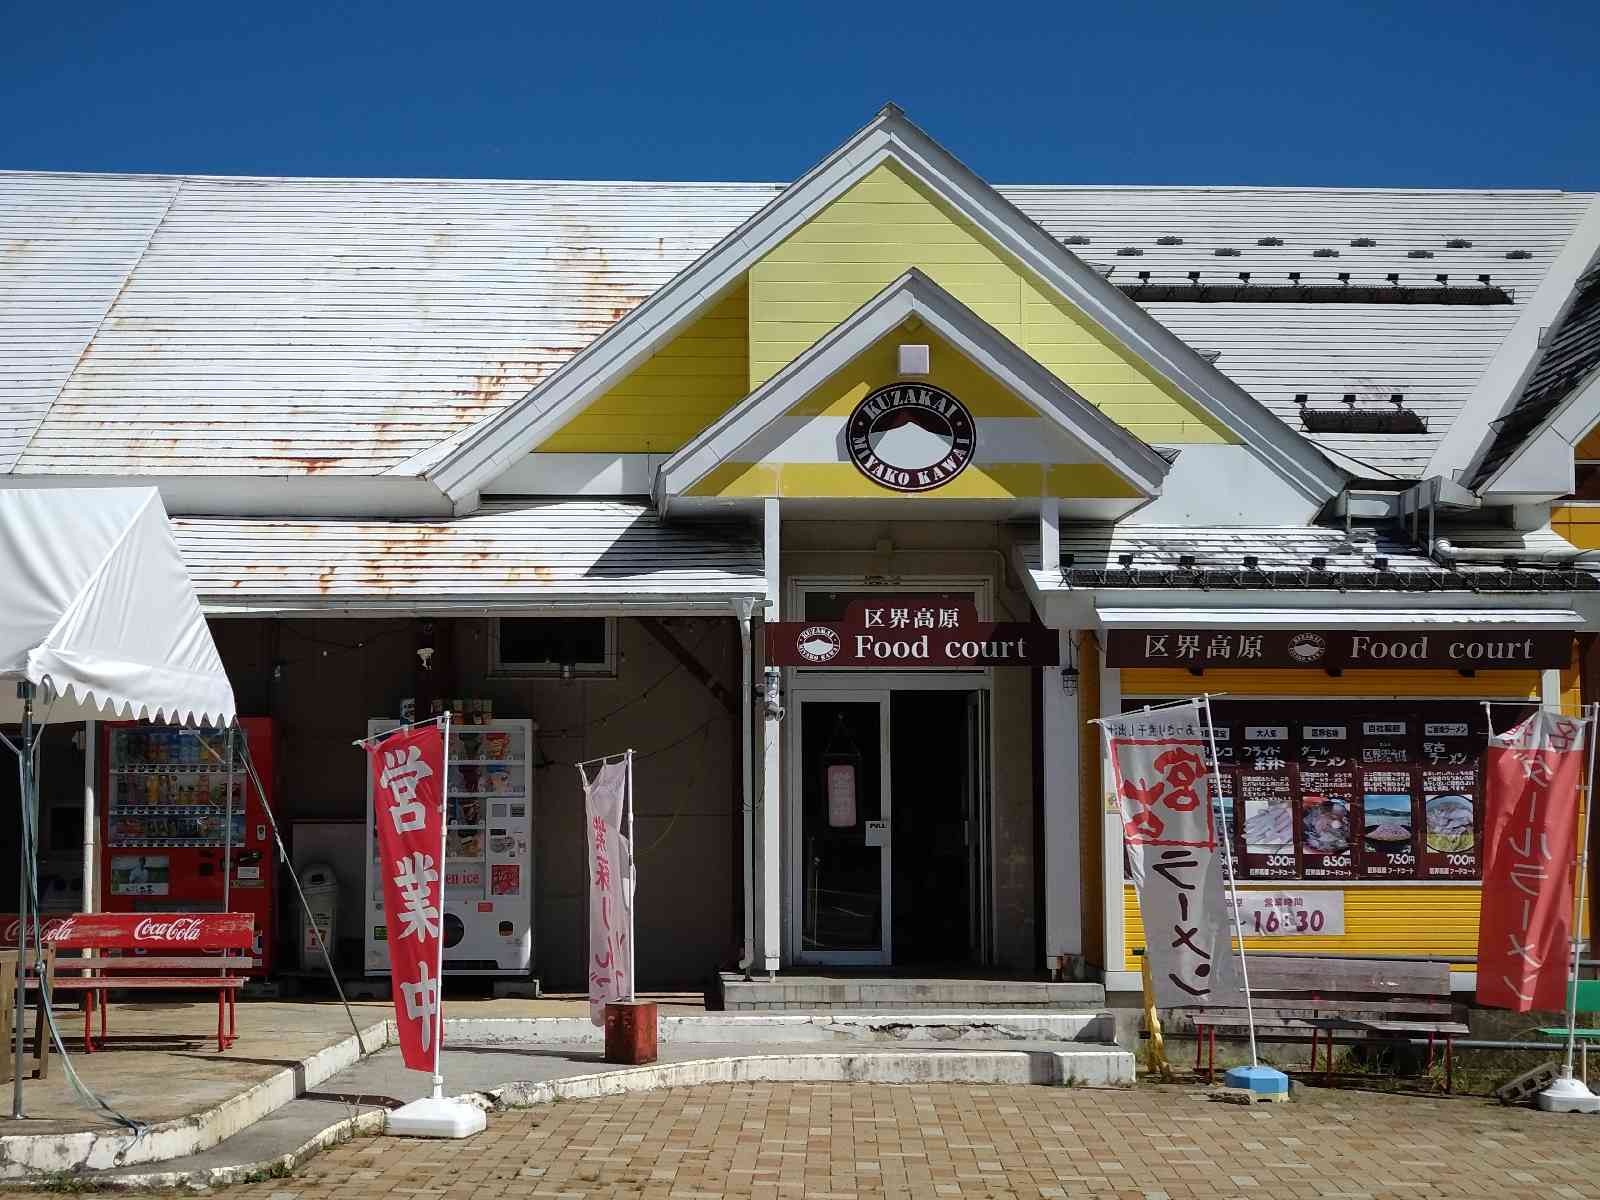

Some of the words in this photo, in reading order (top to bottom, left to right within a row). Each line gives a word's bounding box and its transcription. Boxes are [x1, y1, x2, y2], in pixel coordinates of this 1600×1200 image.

[862, 388, 959, 420] KUZAKAI
[852, 433, 910, 487] MIYAKO
[917, 437, 970, 486] KAWAI
[864, 608, 960, 629] 区界高原
[854, 635, 930, 659] Food
[944, 640, 1028, 659] court
[1145, 634, 1264, 658] 区界高原
[1350, 636, 1429, 659] Food
[1449, 638, 1534, 659] court
[1306, 756, 1347, 768] ラーメン
[1429, 752, 1467, 766] ラーメン
[1266, 855, 1296, 867] 300円
[1322, 856, 1351, 867] 850円
[1388, 854, 1415, 865] 750円
[1447, 854, 1476, 865] 700円
[380, 746, 438, 1052] 営業中
[1253, 910, 1325, 933] 16:30
